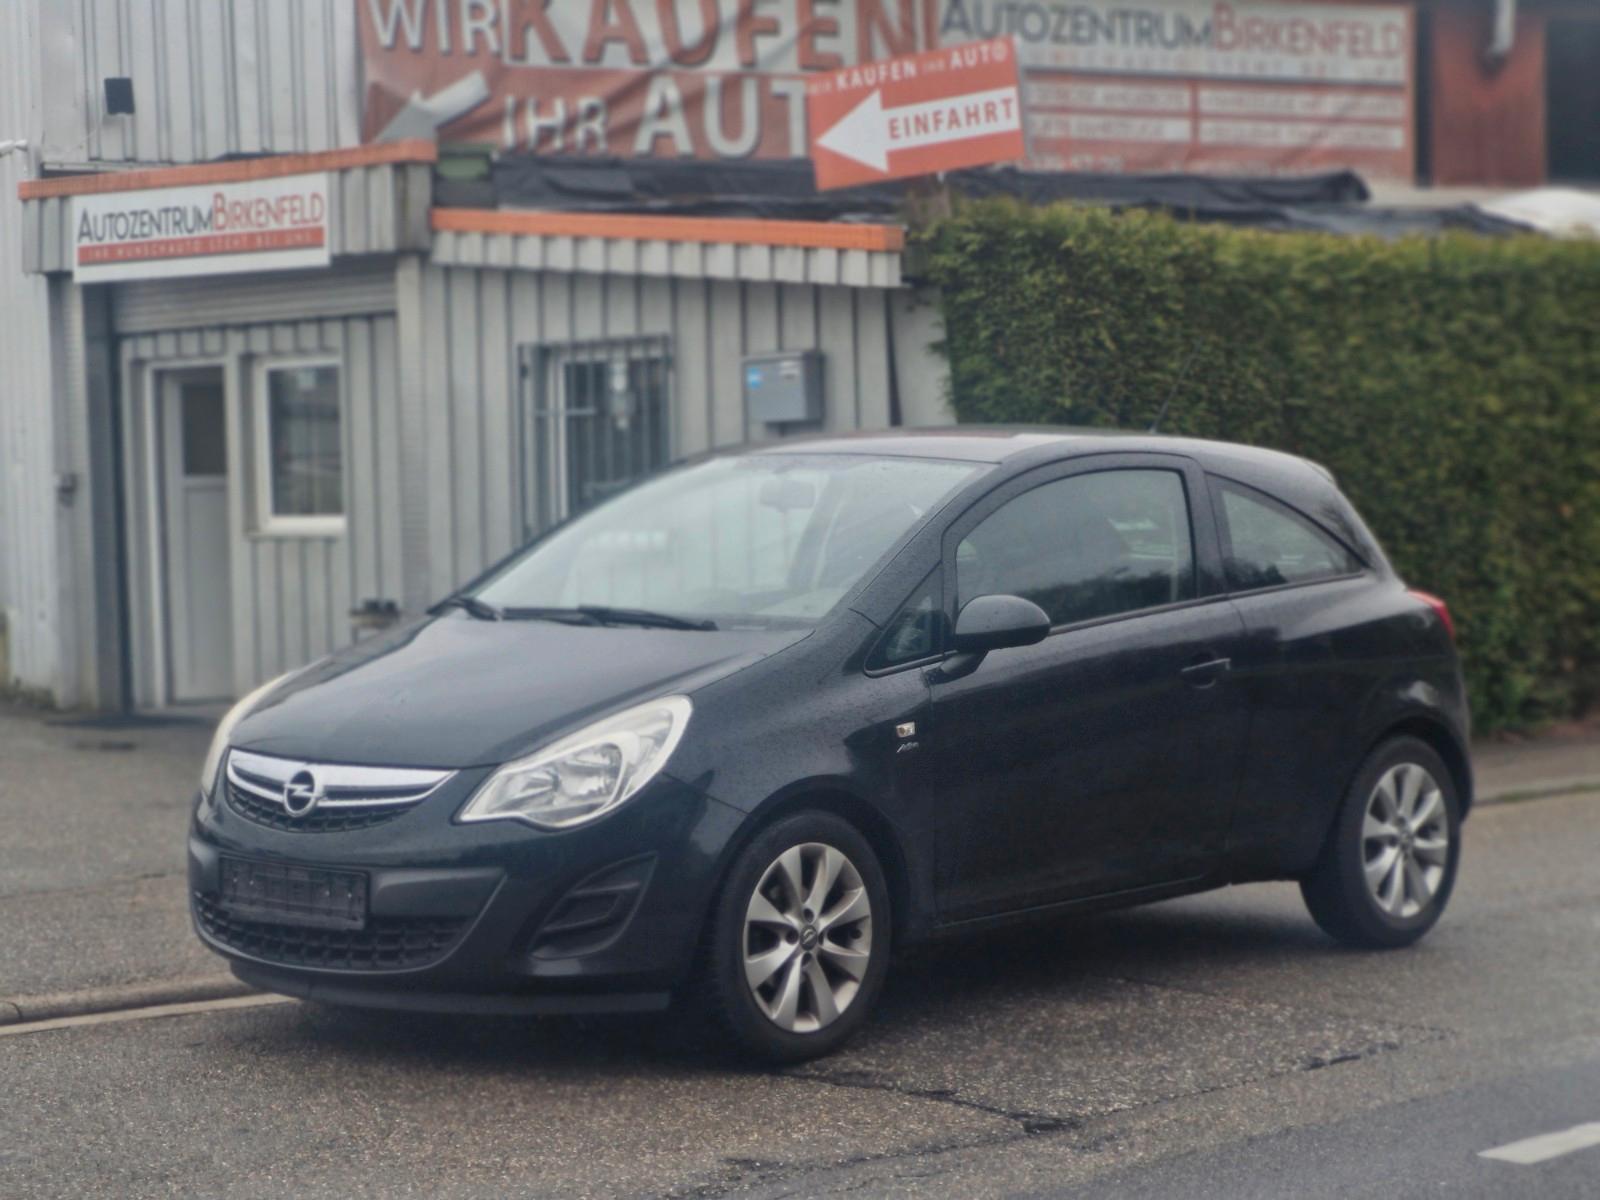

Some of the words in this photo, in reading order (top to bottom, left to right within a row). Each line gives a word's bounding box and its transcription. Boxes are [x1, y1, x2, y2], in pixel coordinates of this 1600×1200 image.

[367, 0, 499, 53] WIR
[507, 0, 915, 69] KAUFEN
[836, 61, 917, 91] KAUFEN
[950, 40, 1009, 70] AUTO
[502, 94, 609, 153] IHR
[634, 74, 808, 159] AUT
[888, 97, 1014, 140] EINFAHRT
